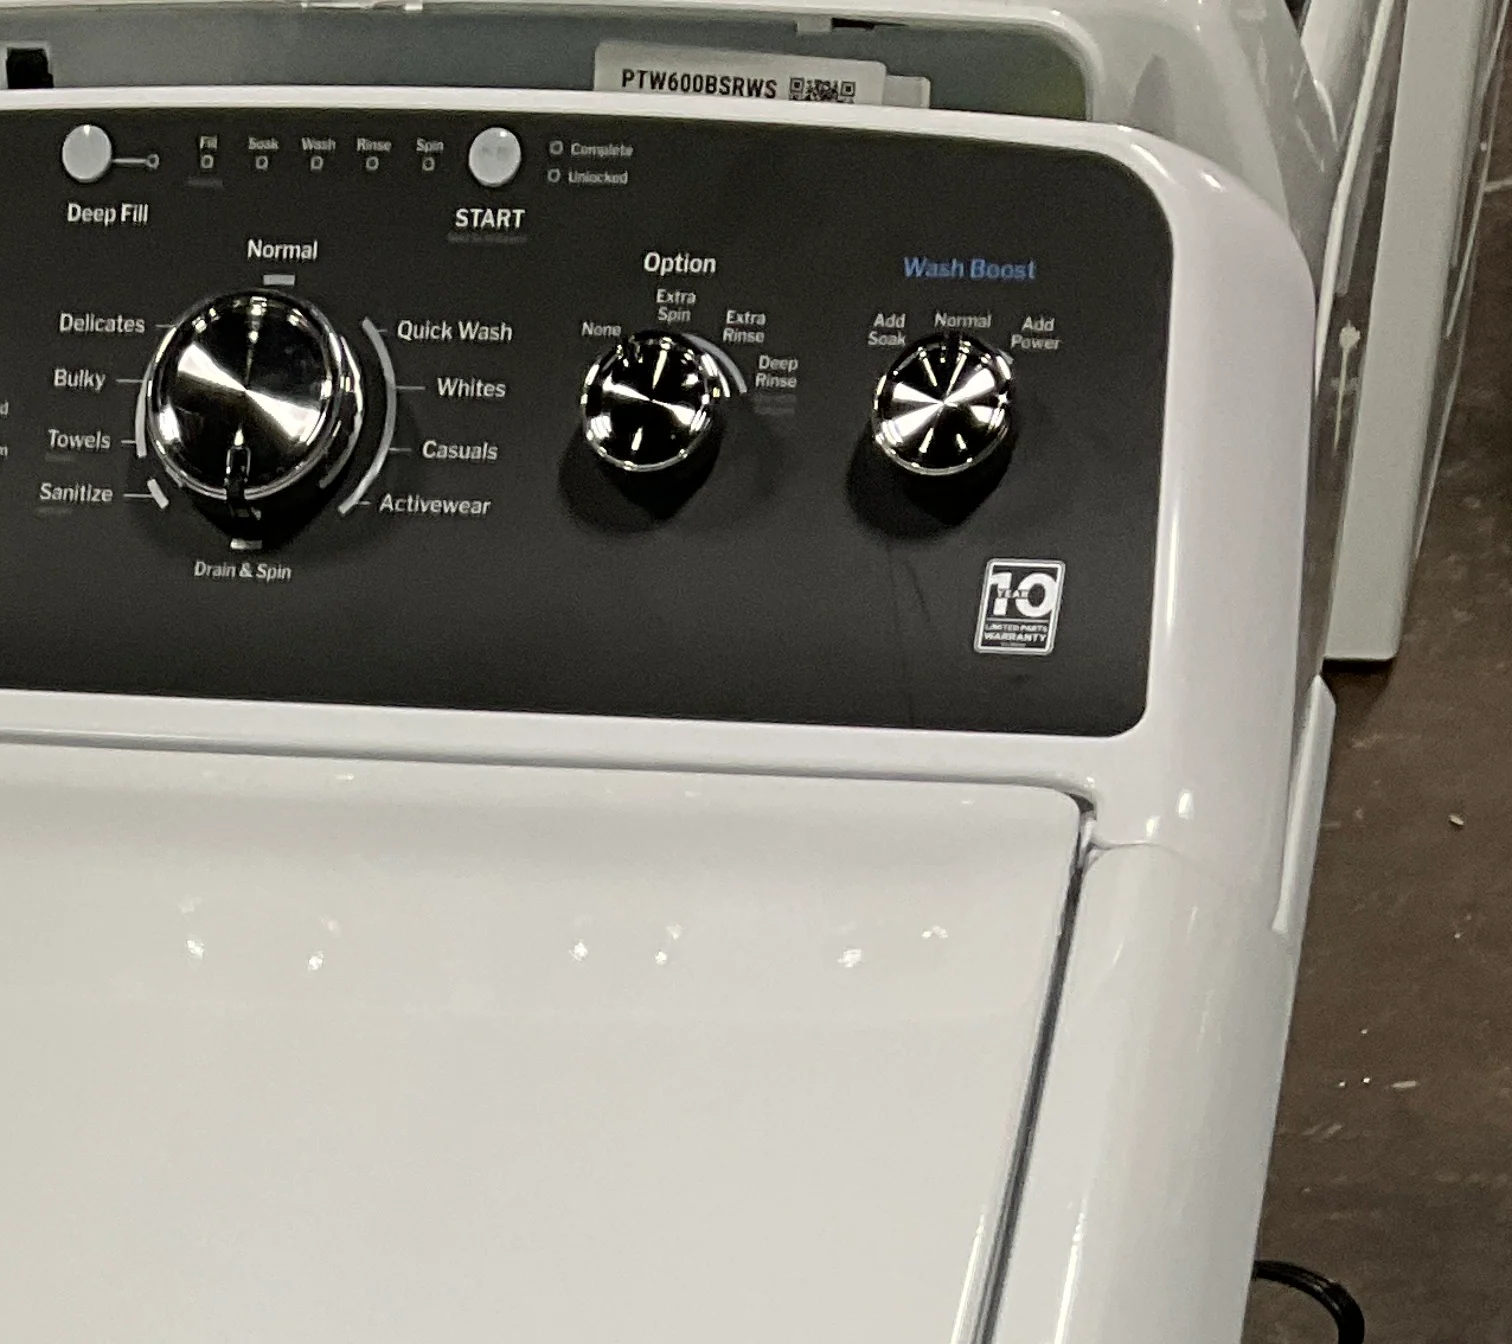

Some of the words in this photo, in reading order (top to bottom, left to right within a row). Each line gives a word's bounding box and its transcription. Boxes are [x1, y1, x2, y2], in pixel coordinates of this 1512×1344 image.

[621, 68, 777, 99] PTW600BSRWS
[356, 137, 392, 152] Rinse
[67, 202, 116, 226] Deep
[120, 203, 149, 225] Fill
[455, 207, 525, 228] START
[247, 238, 318, 260] Normal
[644, 251, 717, 276] Option
[904, 256, 964, 279] Wash
[970, 258, 1037, 281] Boost
[655, 289, 697, 306] Extra
[59, 312, 146, 333] Delicates
[658, 306, 693, 325] Spin
[726, 310, 767, 327] Extra
[873, 313, 906, 330] Add
[934, 312, 993, 330] Normal
[1021, 316, 1056, 333] Add
[397, 320, 453, 341] Quick
[458, 321, 513, 342] Wash
[581, 321, 622, 339] None
[722, 327, 766, 345] Rinse
[867, 331, 906, 348] Soak
[1010, 333, 1061, 351] Power
[758, 355, 800, 373] Deep
[53, 368, 106, 391] Bulky
[438, 377, 507, 399] Whites
[754, 372, 798, 389] Rinse
[48, 428, 112, 451] Towels
[422, 440, 499, 462] Casuals
[39, 483, 114, 503] Sanitize
[379, 494, 492, 517] Activewear
[193, 560, 237, 579] Drain
[238, 562, 253, 579] &
[255, 563, 292, 583] Spin
[988, 571, 1058, 618] 10
